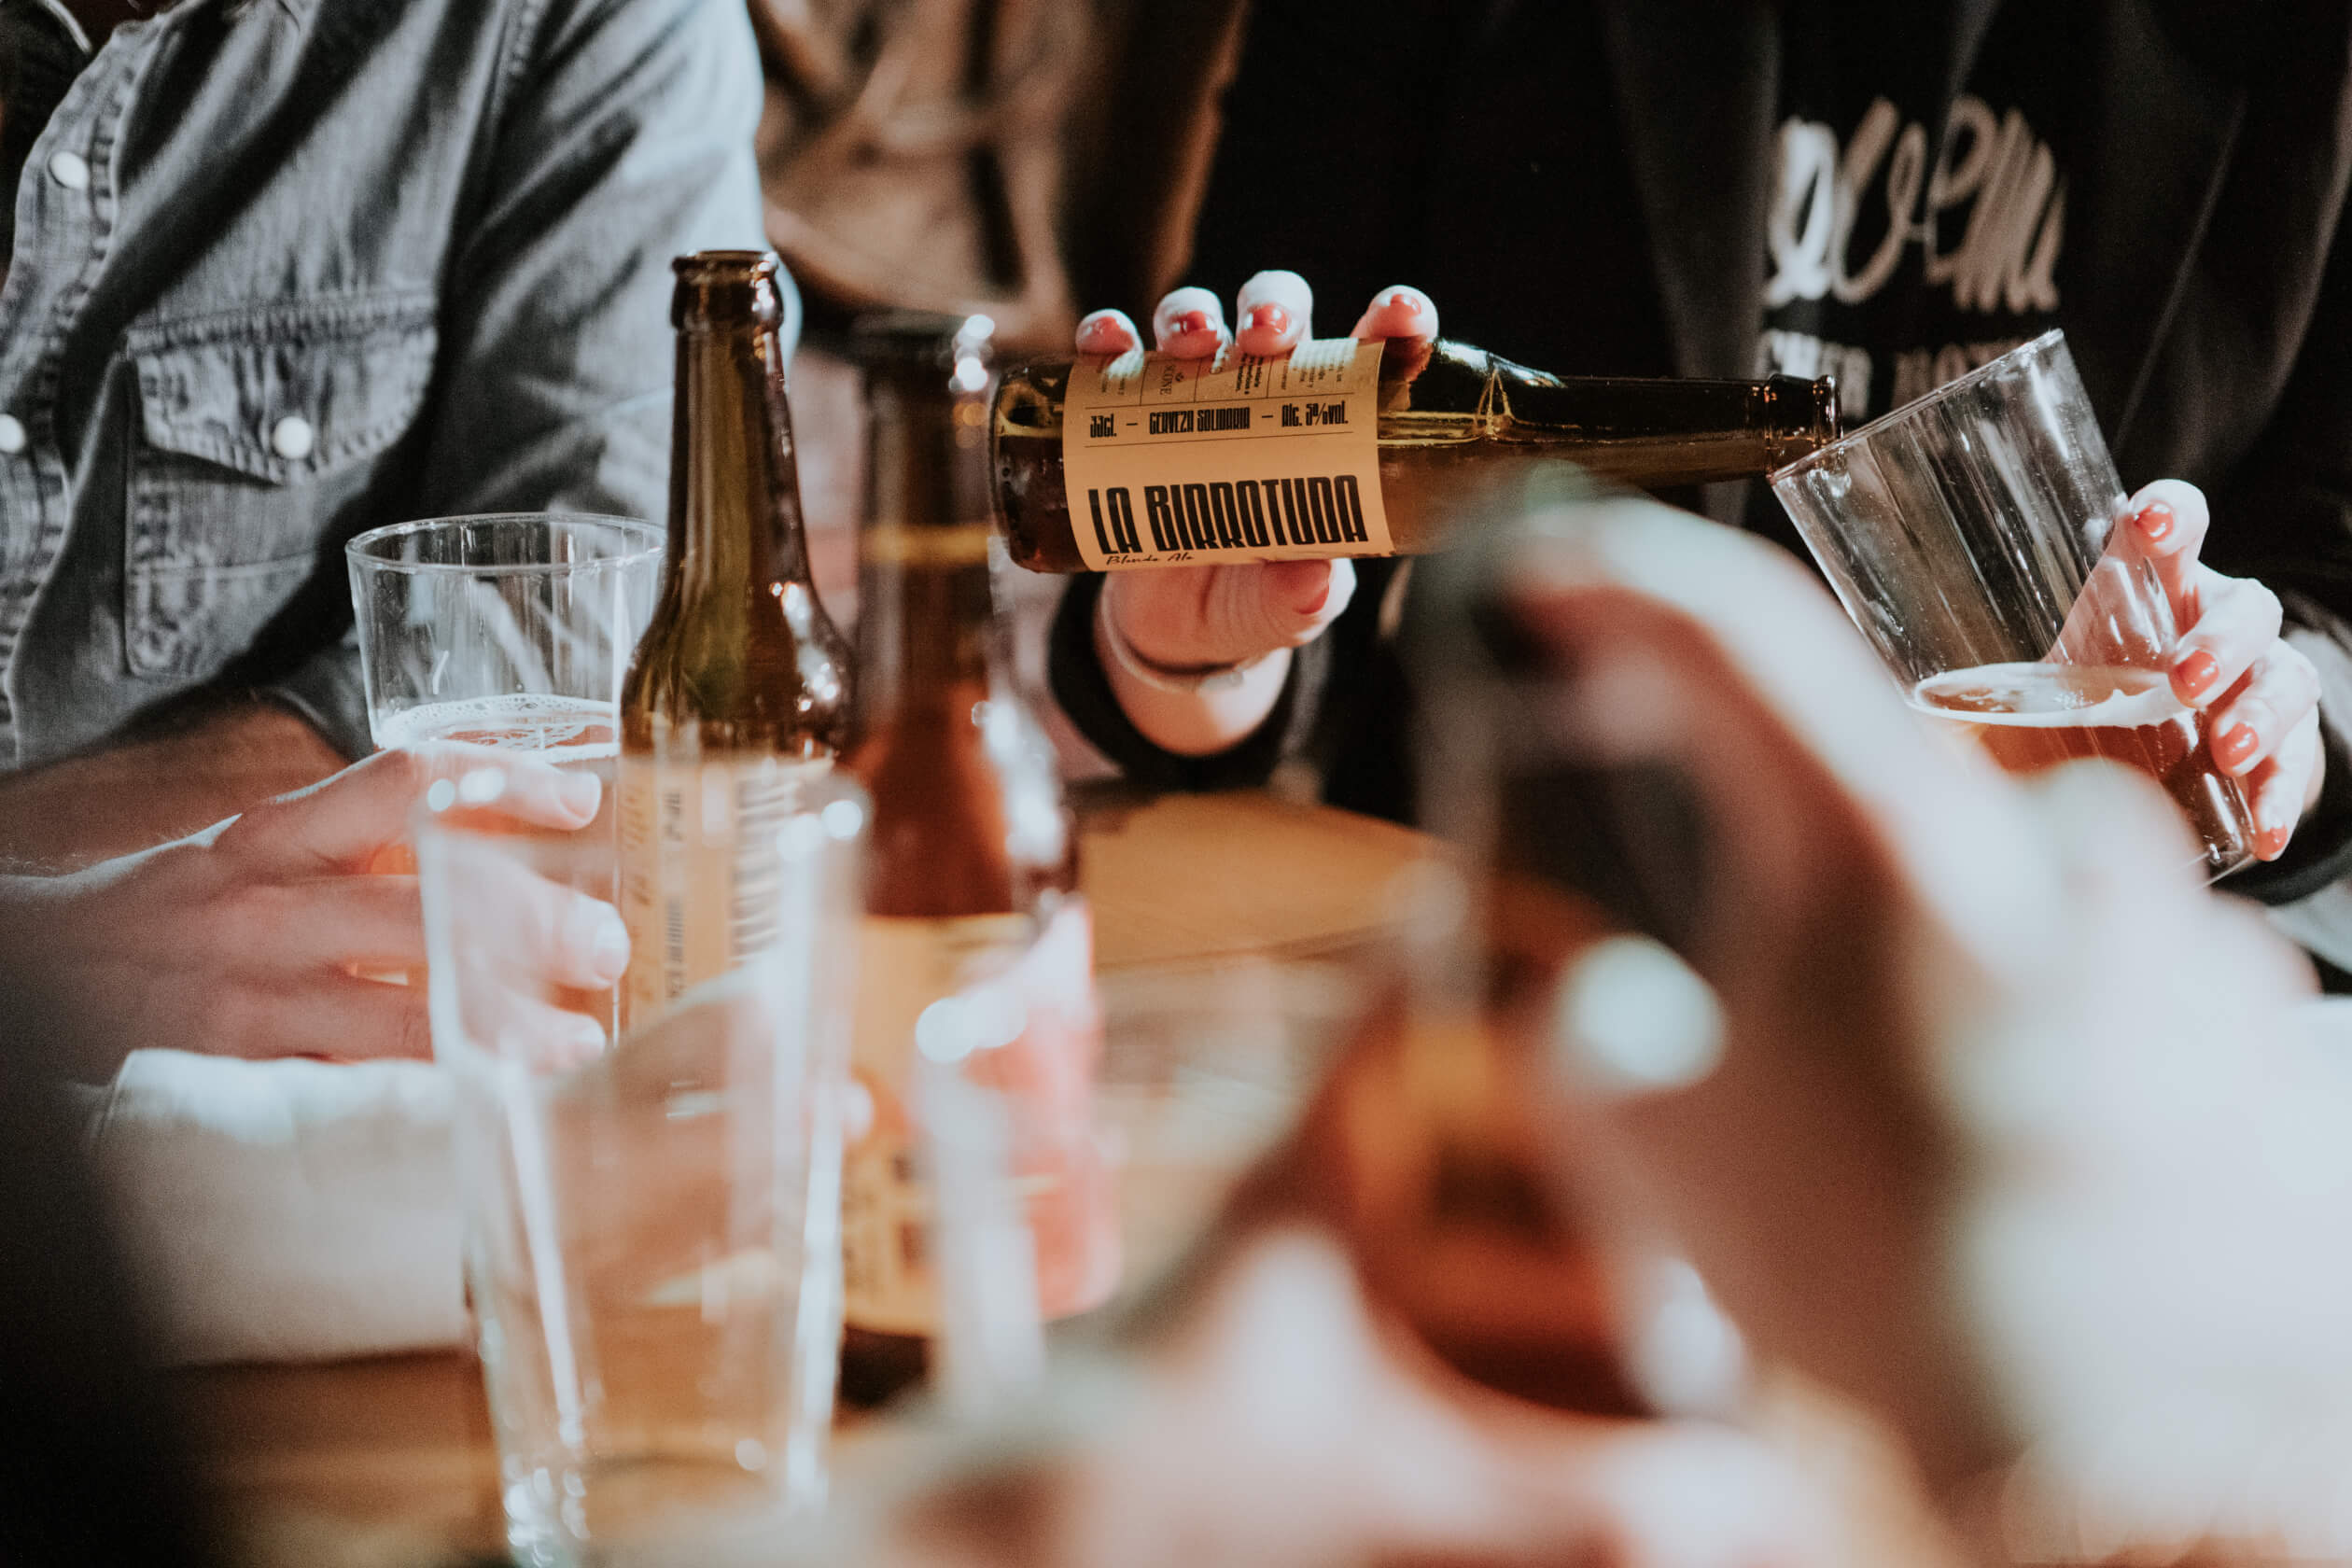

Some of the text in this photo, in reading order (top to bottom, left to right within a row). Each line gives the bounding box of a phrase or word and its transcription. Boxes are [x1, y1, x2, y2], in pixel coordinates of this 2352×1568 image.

[1149, 410, 1195, 435] CERVEZA
[1197, 407, 1250, 432] SOLIDARIA
[1088, 474, 1369, 554] LA BIRROTUDA
[1167, 552, 1196, 562] Ale
